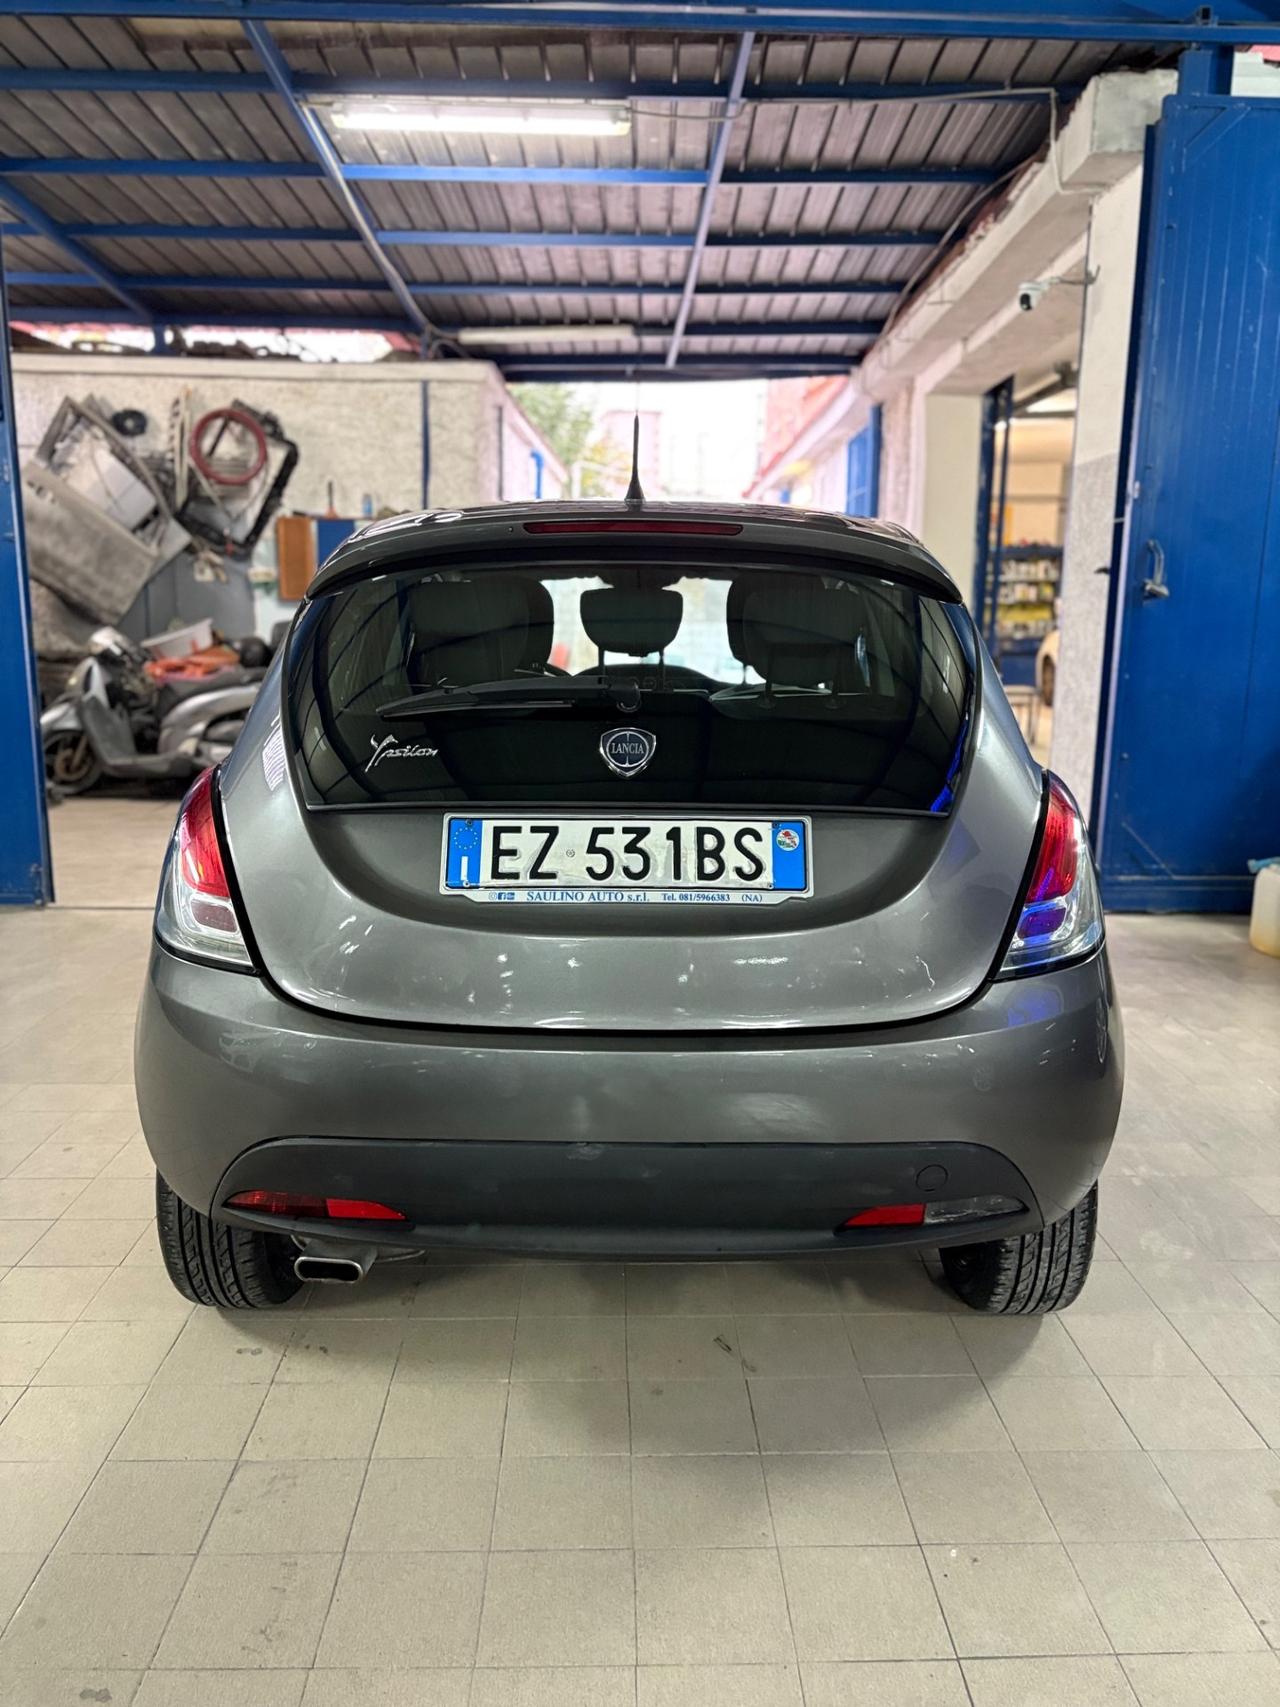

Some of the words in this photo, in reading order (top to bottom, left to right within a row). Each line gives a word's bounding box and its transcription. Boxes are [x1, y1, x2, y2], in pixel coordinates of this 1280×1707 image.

[365, 734, 439, 772] Ypsilon
[611, 743, 645, 754] LANCIA
[491, 826, 559, 880] EZ
[585, 827, 764, 881] 531BS
[527, 891, 585, 902] SAULINO
[588, 892, 625, 902] AUTO
[627, 892, 650, 902] s.r.l.
[661, 893, 676, 902] Tel.
[678, 893, 731, 903] 081/5966383
[741, 893, 763, 903] (NA)
